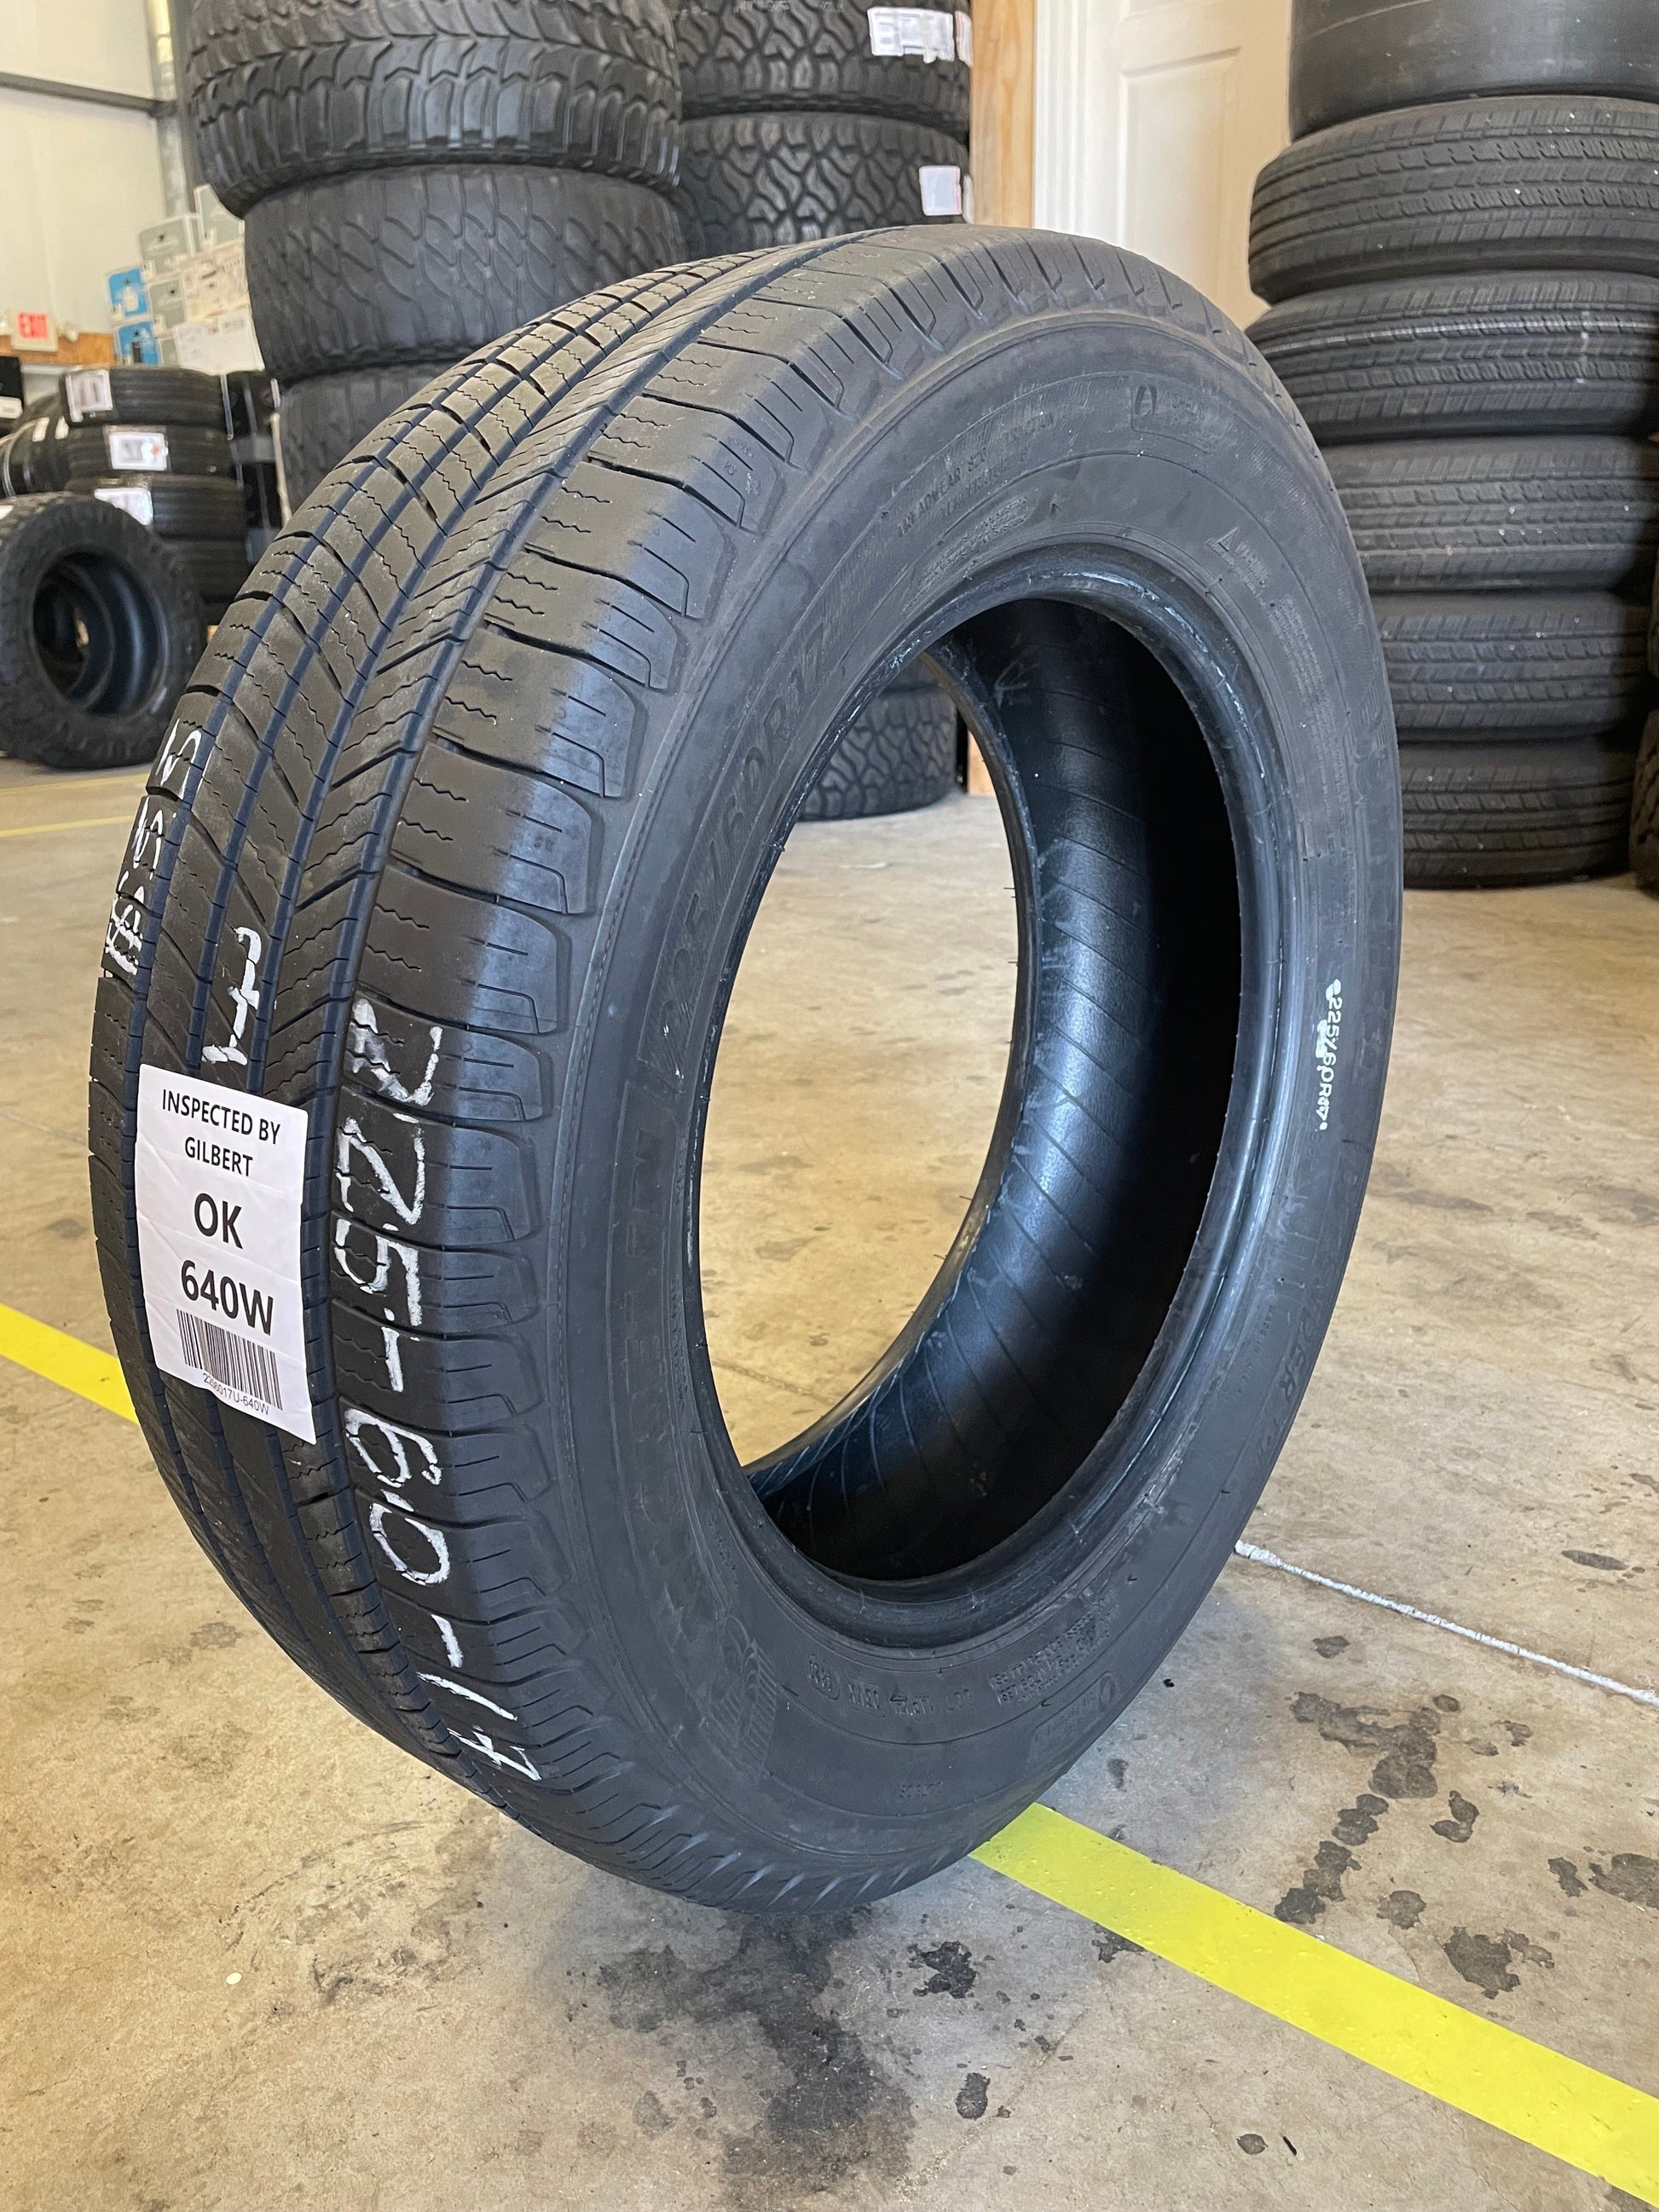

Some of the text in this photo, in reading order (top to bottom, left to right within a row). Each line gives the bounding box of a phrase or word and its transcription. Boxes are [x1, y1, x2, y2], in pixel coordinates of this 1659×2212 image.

[17, 312, 49, 340] EXIT
[162, 1089, 281, 1146] INSPECTED BY
[184, 1135, 254, 1177] GILBERT
[194, 1193, 244, 1250] OK
[180, 1260, 275, 1337] 640W
